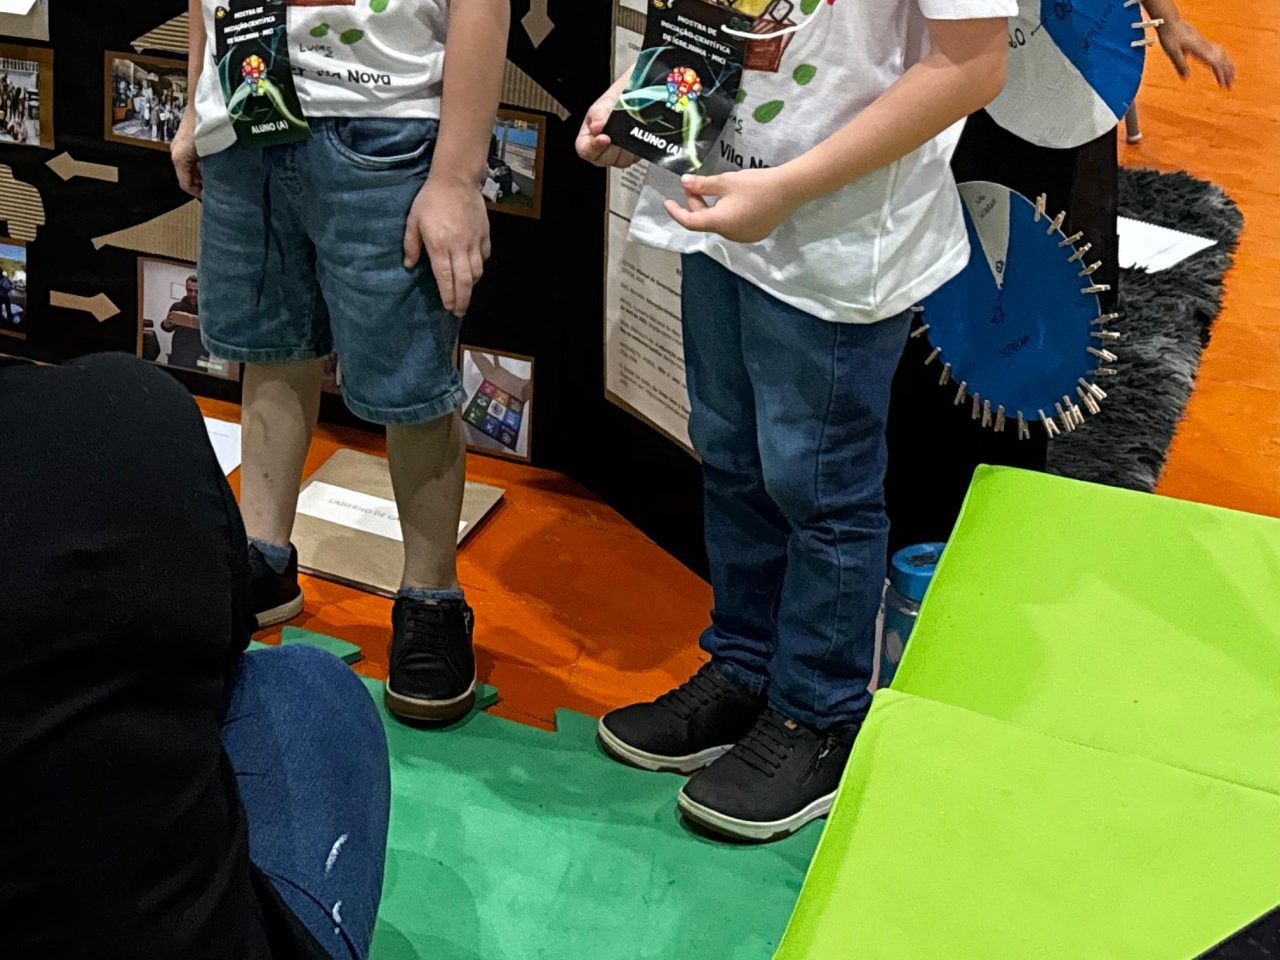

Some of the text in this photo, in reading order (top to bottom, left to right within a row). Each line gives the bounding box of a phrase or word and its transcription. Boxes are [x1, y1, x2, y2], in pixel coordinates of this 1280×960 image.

[347, 69, 391, 85] Nova
[251, 120, 288, 134] ALUNO (A)
[630, 126, 667, 149] ALUNO
[720, 140, 743, 168] Vila
